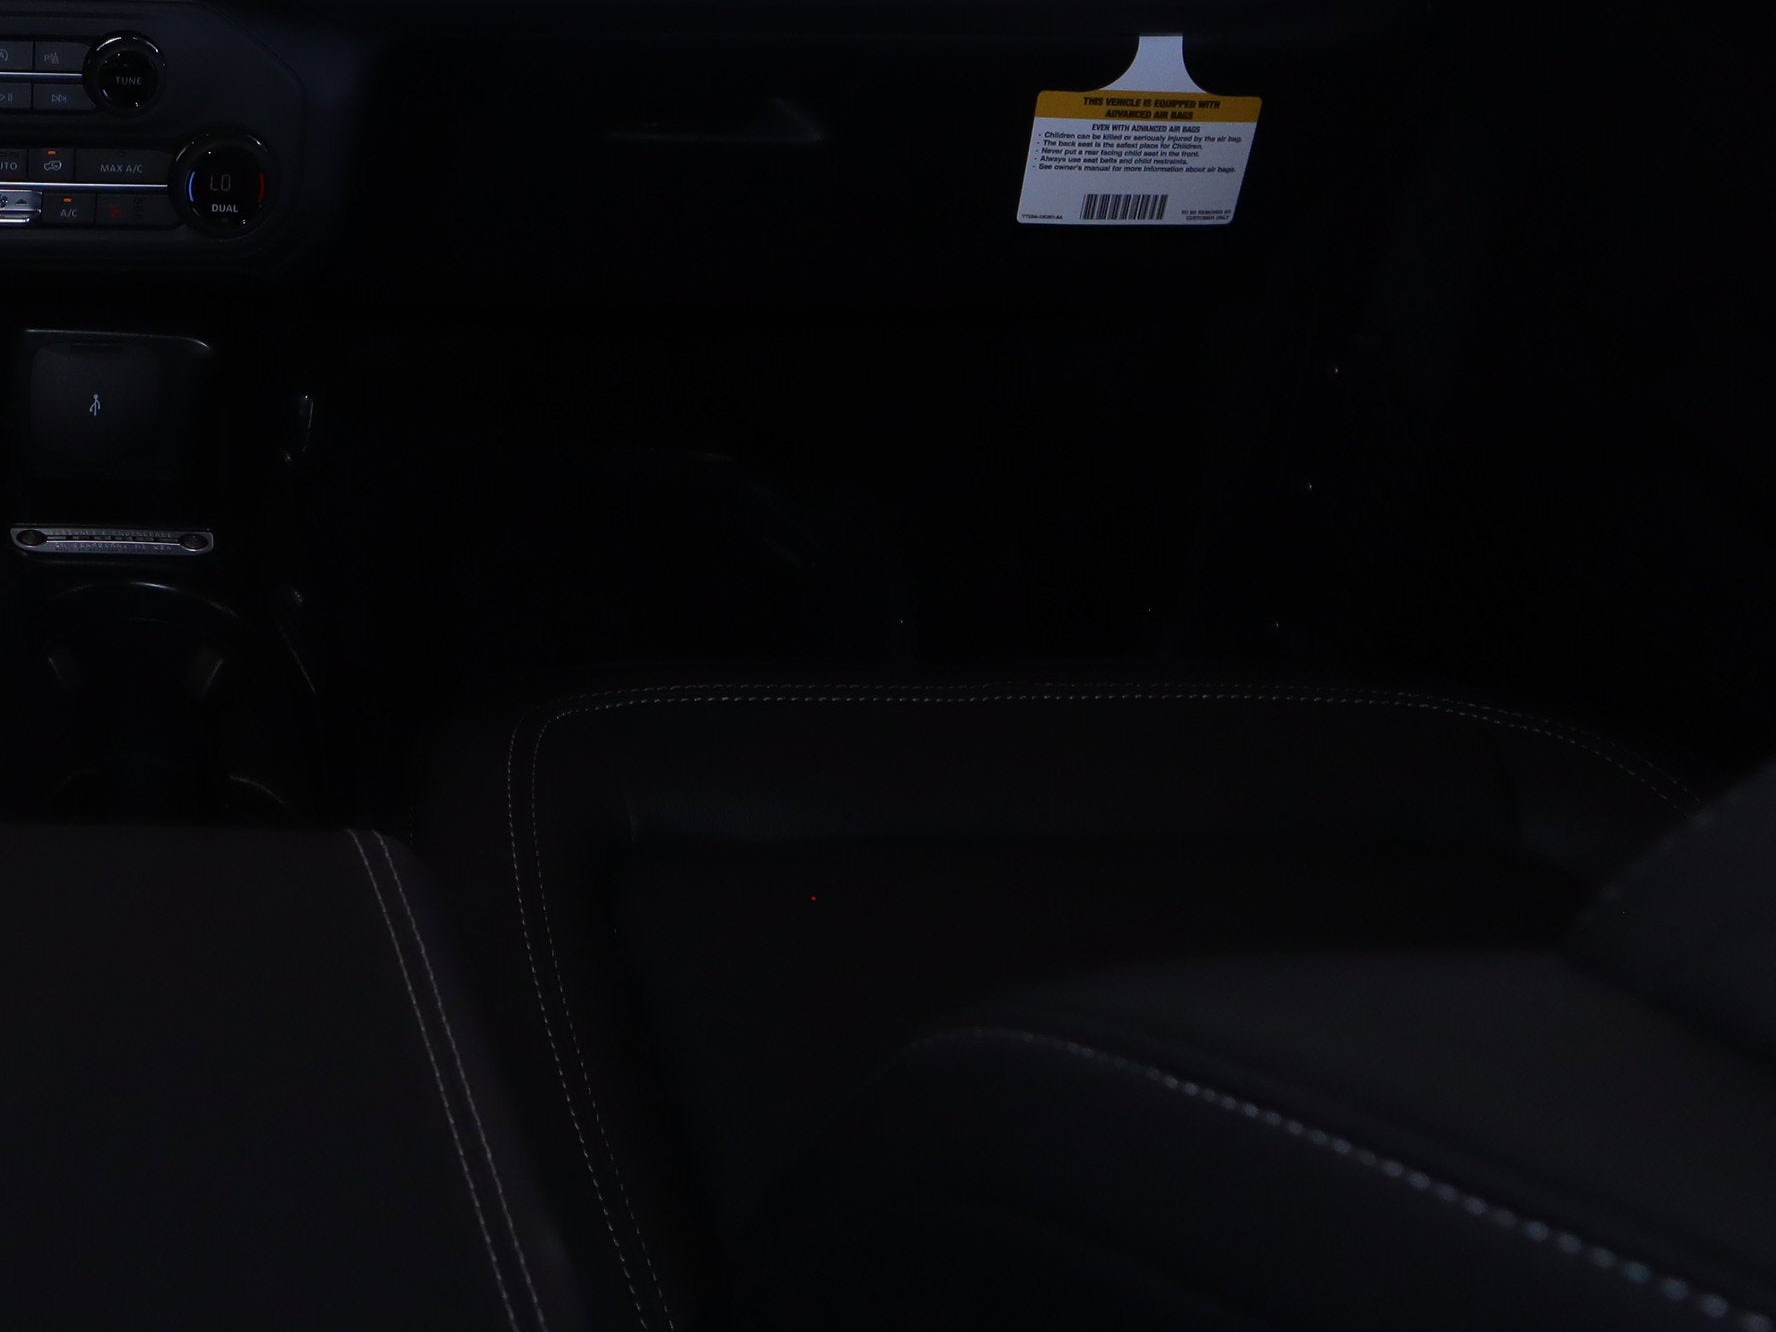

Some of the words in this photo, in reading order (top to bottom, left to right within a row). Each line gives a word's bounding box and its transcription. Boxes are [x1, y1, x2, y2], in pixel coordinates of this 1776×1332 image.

[115, 76, 143, 85] TUNE
[1084, 97, 1103, 106] THIS
[1106, 98, 1141, 107] VEHICLE
[1143, 99, 1152, 107] IS
[1153, 99, 1196, 108] EQUIPPED
[1199, 100, 1221, 109] WITH
[1105, 109, 1152, 118] ADVANCED
[1153, 110, 1168, 119] AIR
[1171, 111, 1194, 119] BAGS
[1131, 125, 1167, 133] ADVANCED
[100, 164, 123, 173] MAX
[126, 164, 144, 174] A/C
[211, 204, 239, 213] DUAL
[60, 209, 78, 218] A/C
